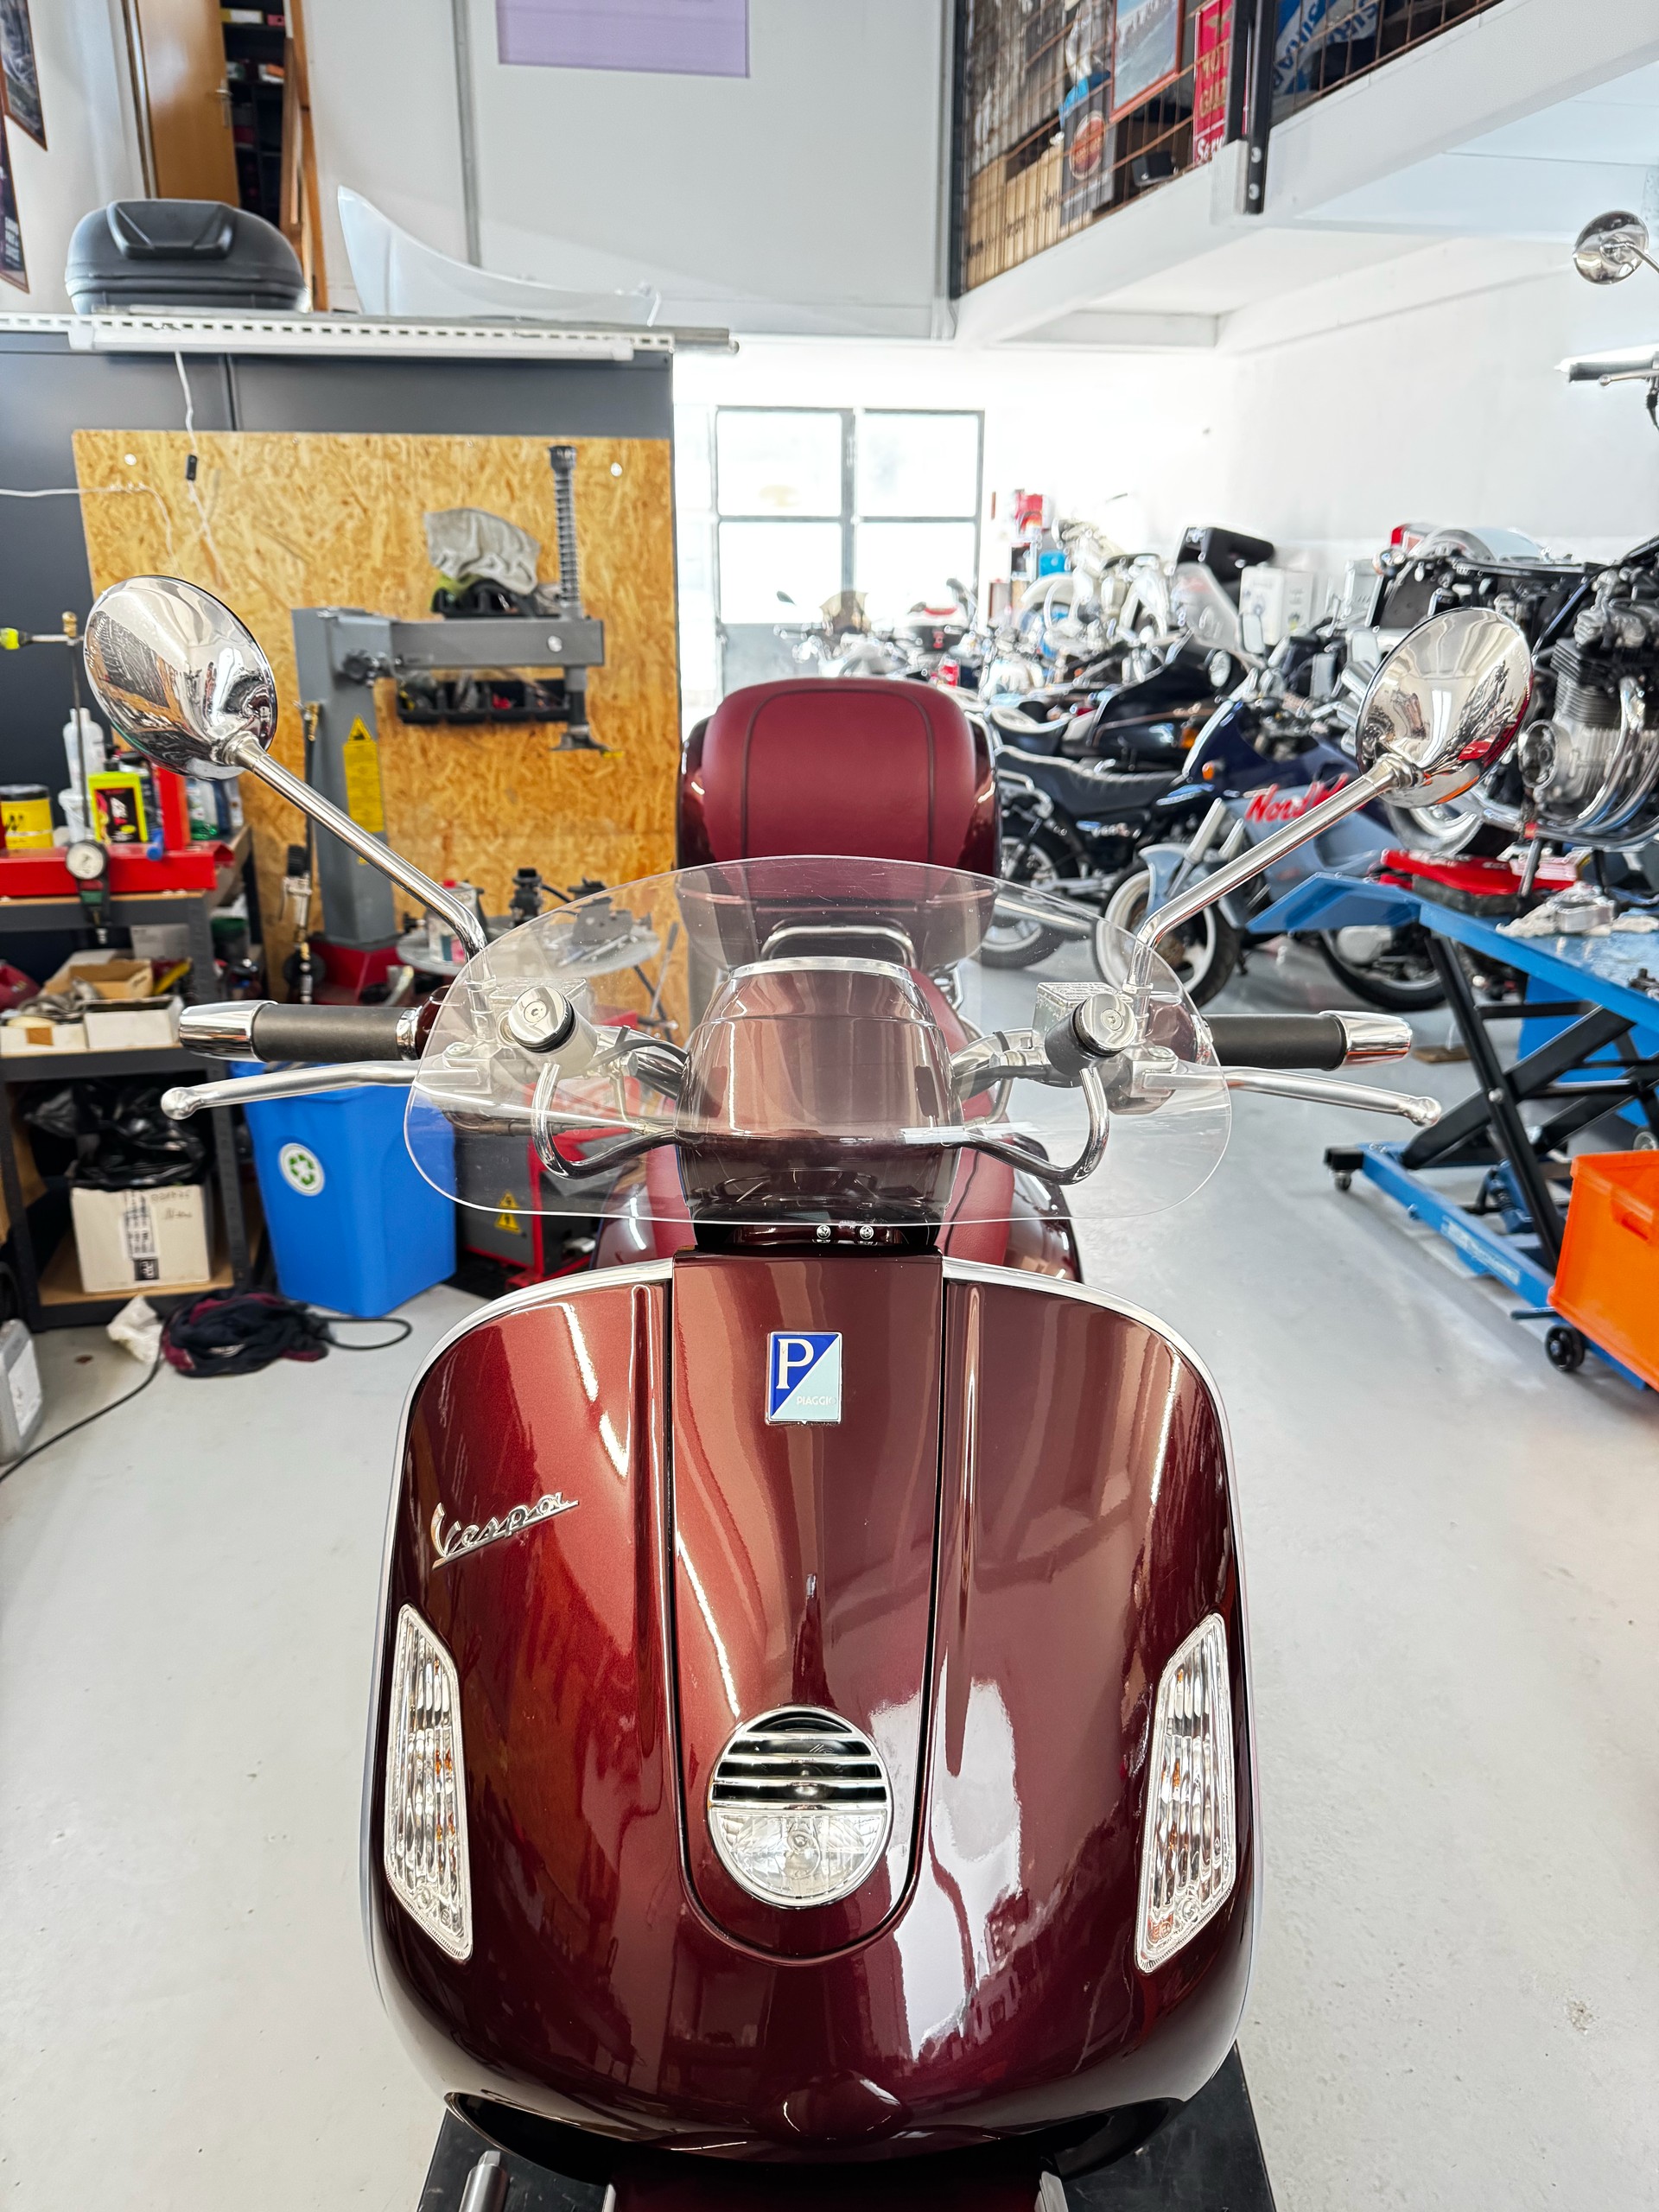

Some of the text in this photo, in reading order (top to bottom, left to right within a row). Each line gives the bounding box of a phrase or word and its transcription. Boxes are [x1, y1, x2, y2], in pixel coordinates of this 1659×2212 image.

[775, 1338, 815, 1389] P
[796, 1395, 837, 1407] PIAGGIO
[430, 1491, 580, 1571] Vespa
